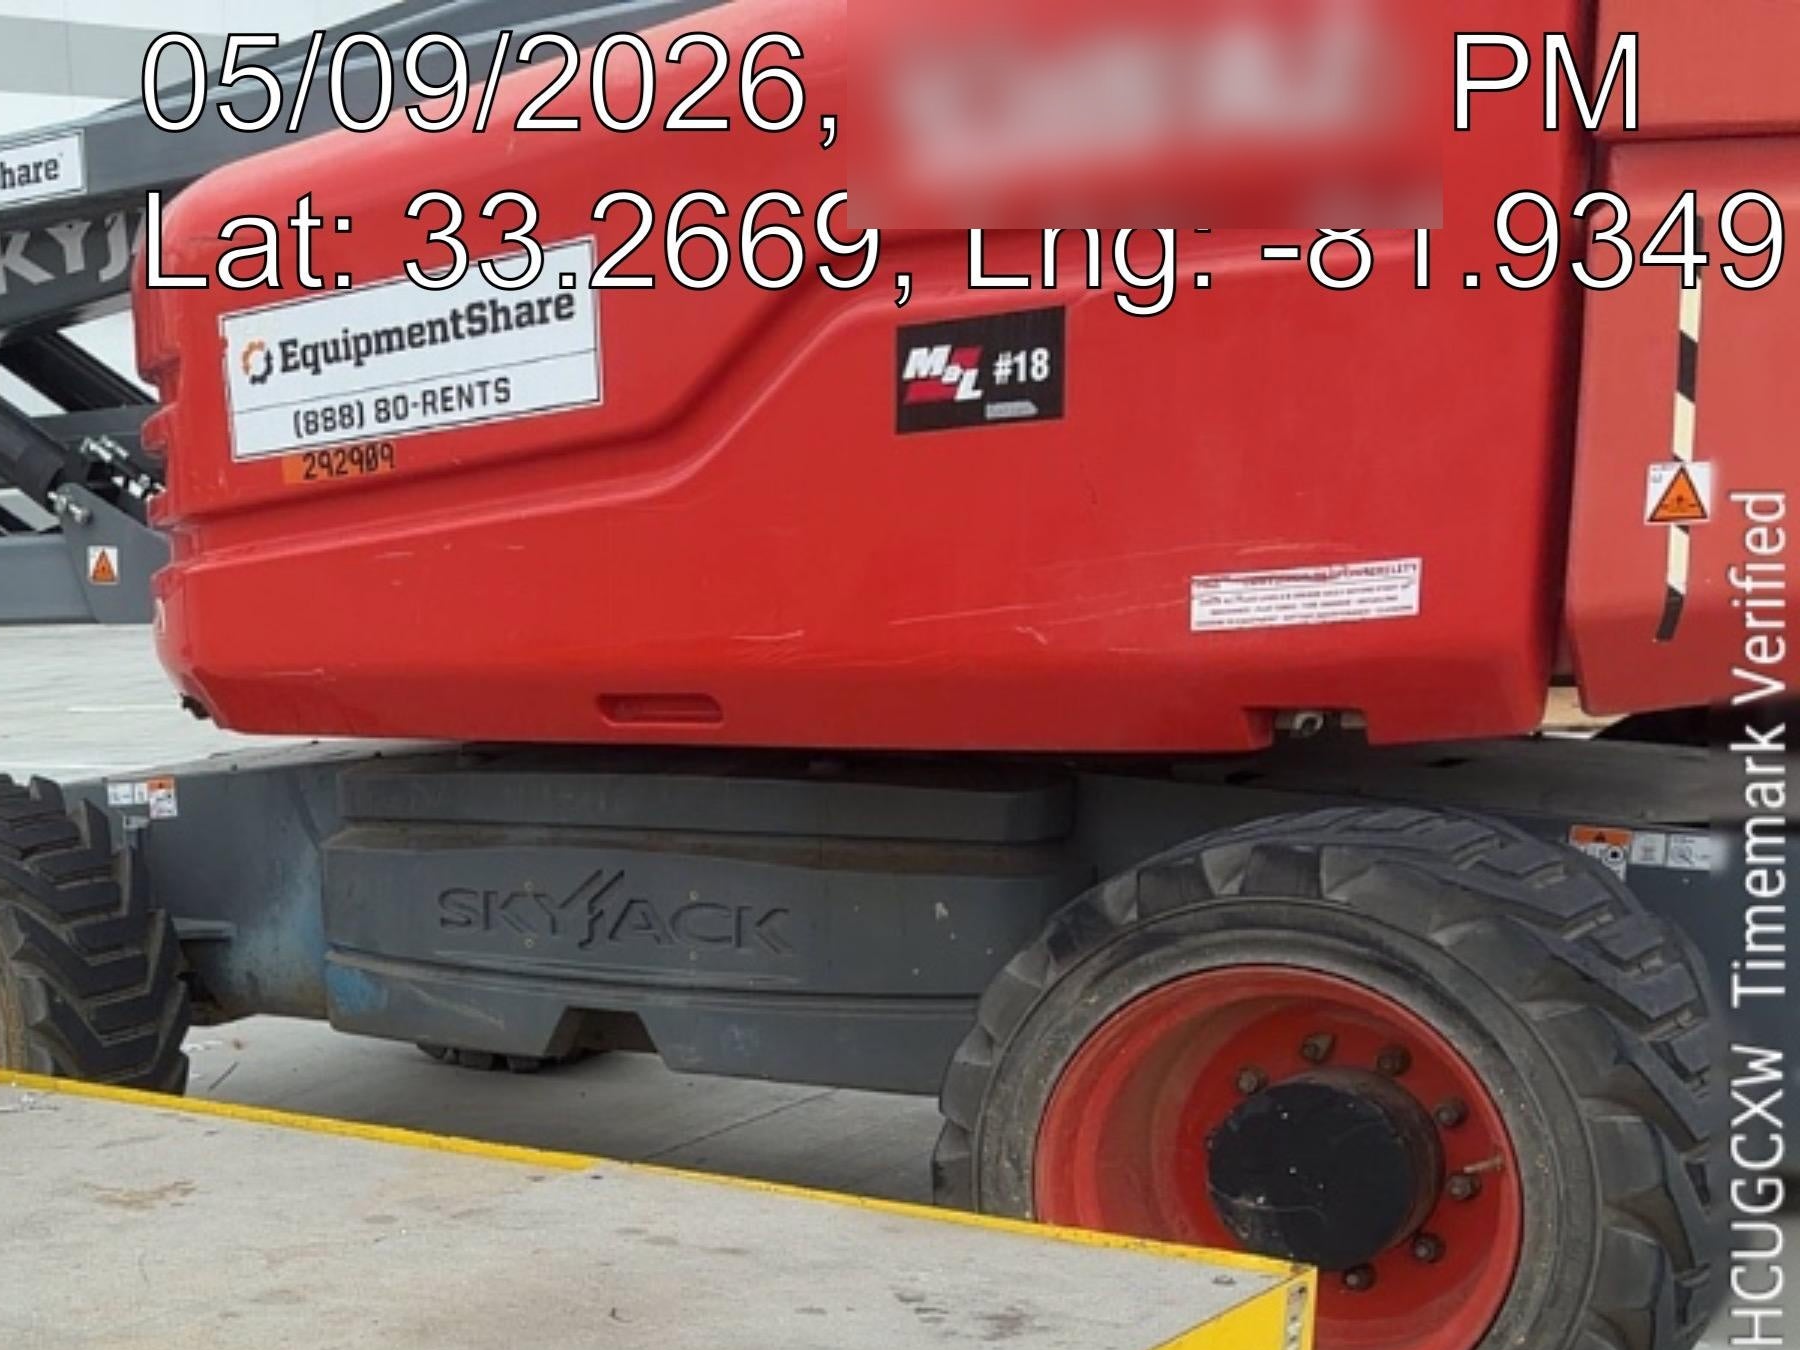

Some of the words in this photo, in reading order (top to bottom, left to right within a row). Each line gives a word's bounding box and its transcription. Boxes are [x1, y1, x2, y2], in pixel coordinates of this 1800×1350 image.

[279, 291, 576, 377] EquipmentShare
[992, 346, 1050, 386] #18
[293, 399, 365, 439] (888)
[374, 376, 512, 425] 80-RENTS
[437, 869, 792, 955] SKYJACK
